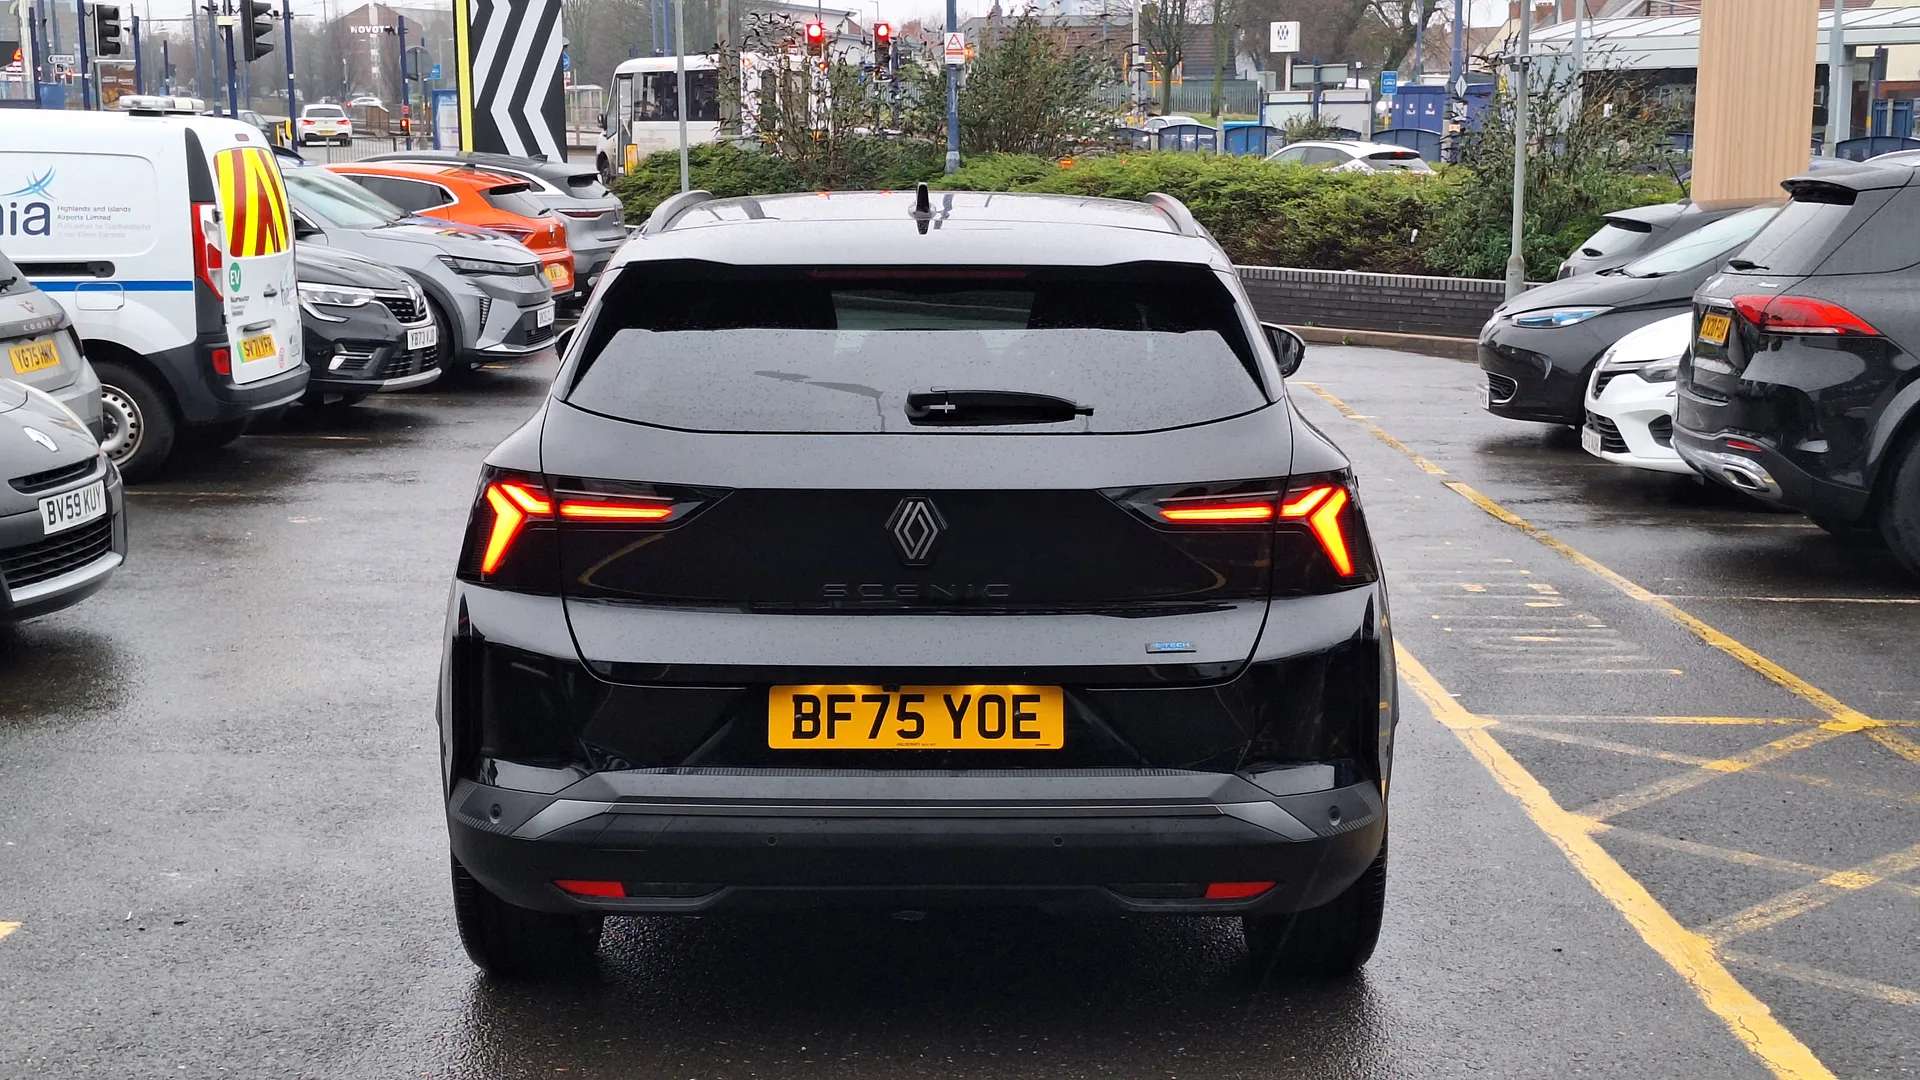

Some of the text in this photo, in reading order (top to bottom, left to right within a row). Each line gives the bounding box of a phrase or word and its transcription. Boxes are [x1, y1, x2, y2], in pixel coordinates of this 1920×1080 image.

[350, 25, 398, 34] NOVOT
[57, 204, 91, 213] Highlands
[230, 269, 240, 285] EV
[14, 346, 40, 369] YG75
[46, 485, 101, 526] BV59 KUY
[822, 583, 1009, 597] SCENIC
[792, 693, 1041, 740] BF75 YOE
